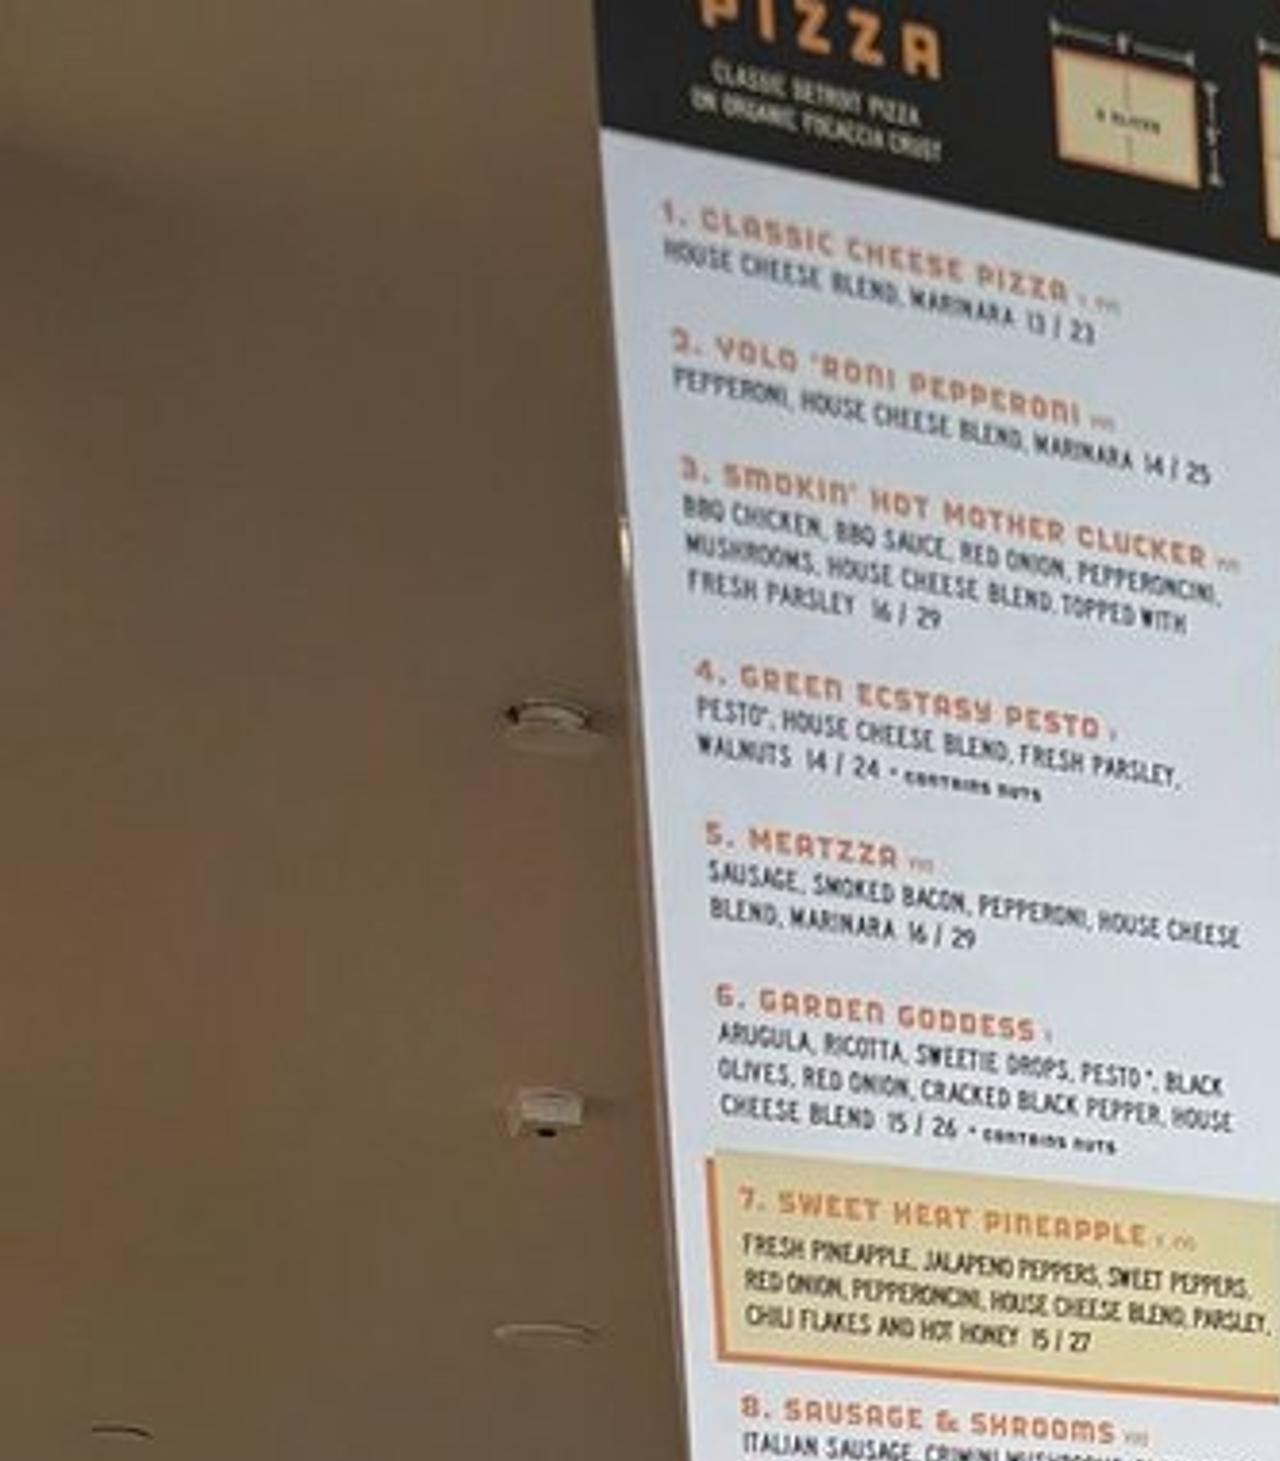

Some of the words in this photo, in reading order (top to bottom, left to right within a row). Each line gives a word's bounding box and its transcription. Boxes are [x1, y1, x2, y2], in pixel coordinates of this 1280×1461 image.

[701, 0, 943, 81] PIZZA
[661, 197, 687, 228] 1.
[699, 204, 834, 258] CLASSIC
[844, 234, 964, 285] CHEESE
[974, 261, 1069, 306] PIZZA
[661, 234, 733, 275] HOUSE
[738, 250, 822, 293] CHEESE
[908, 285, 1015, 328] MARINARA
[1025, 308, 1047, 337] 13
[1068, 316, 1096, 347] 23
[669, 324, 701, 358] 2.
[714, 332, 799, 375] YOLO
[907, 369, 1081, 428] PEPPERONI
[680, 453, 711, 485] 3.
[869, 485, 930, 522] HOT
[941, 498, 1066, 546] MOTHER
[1075, 522, 1207, 571] CLUCKER
[681, 491, 727, 526] BBQ
[833, 517, 877, 551] BBQ
[958, 538, 1001, 571] RED
[686, 566, 759, 604] FRESH
[764, 578, 857, 619] PARSLEY
[870, 596, 893, 624] 16
[915, 604, 943, 633] 29
[693, 657, 727, 686] 4.
[738, 661, 843, 704] GREEN
[855, 679, 993, 727] ECSTASY
[1003, 702, 1100, 742] PESTO
[704, 819, 734, 849] 5.
[747, 824, 899, 871] MEATZZA
[811, 871, 896, 907] SMOKED
[1097, 908, 1161, 940] HOUSE
[1165, 916, 1240, 951] CHEESE
[714, 981, 746, 1010] 6.
[758, 986, 885, 1027] GARDEN
[896, 1002, 1035, 1044] GODDESS
[737, 1183, 766, 1213] 7.
[776, 1187, 883, 1224] SWEET
[891, 1199, 974, 1233] HEAT
[981, 1206, 1150, 1249] PINEAPPLE
[738, 1393, 772, 1420] 8.
[782, 1396, 924, 1432] SAUSAGE
[934, 1408, 960, 1435] &
[969, 1410, 1116, 1446] SHROOMS
[741, 1430, 820, 1458] ITALIAN
